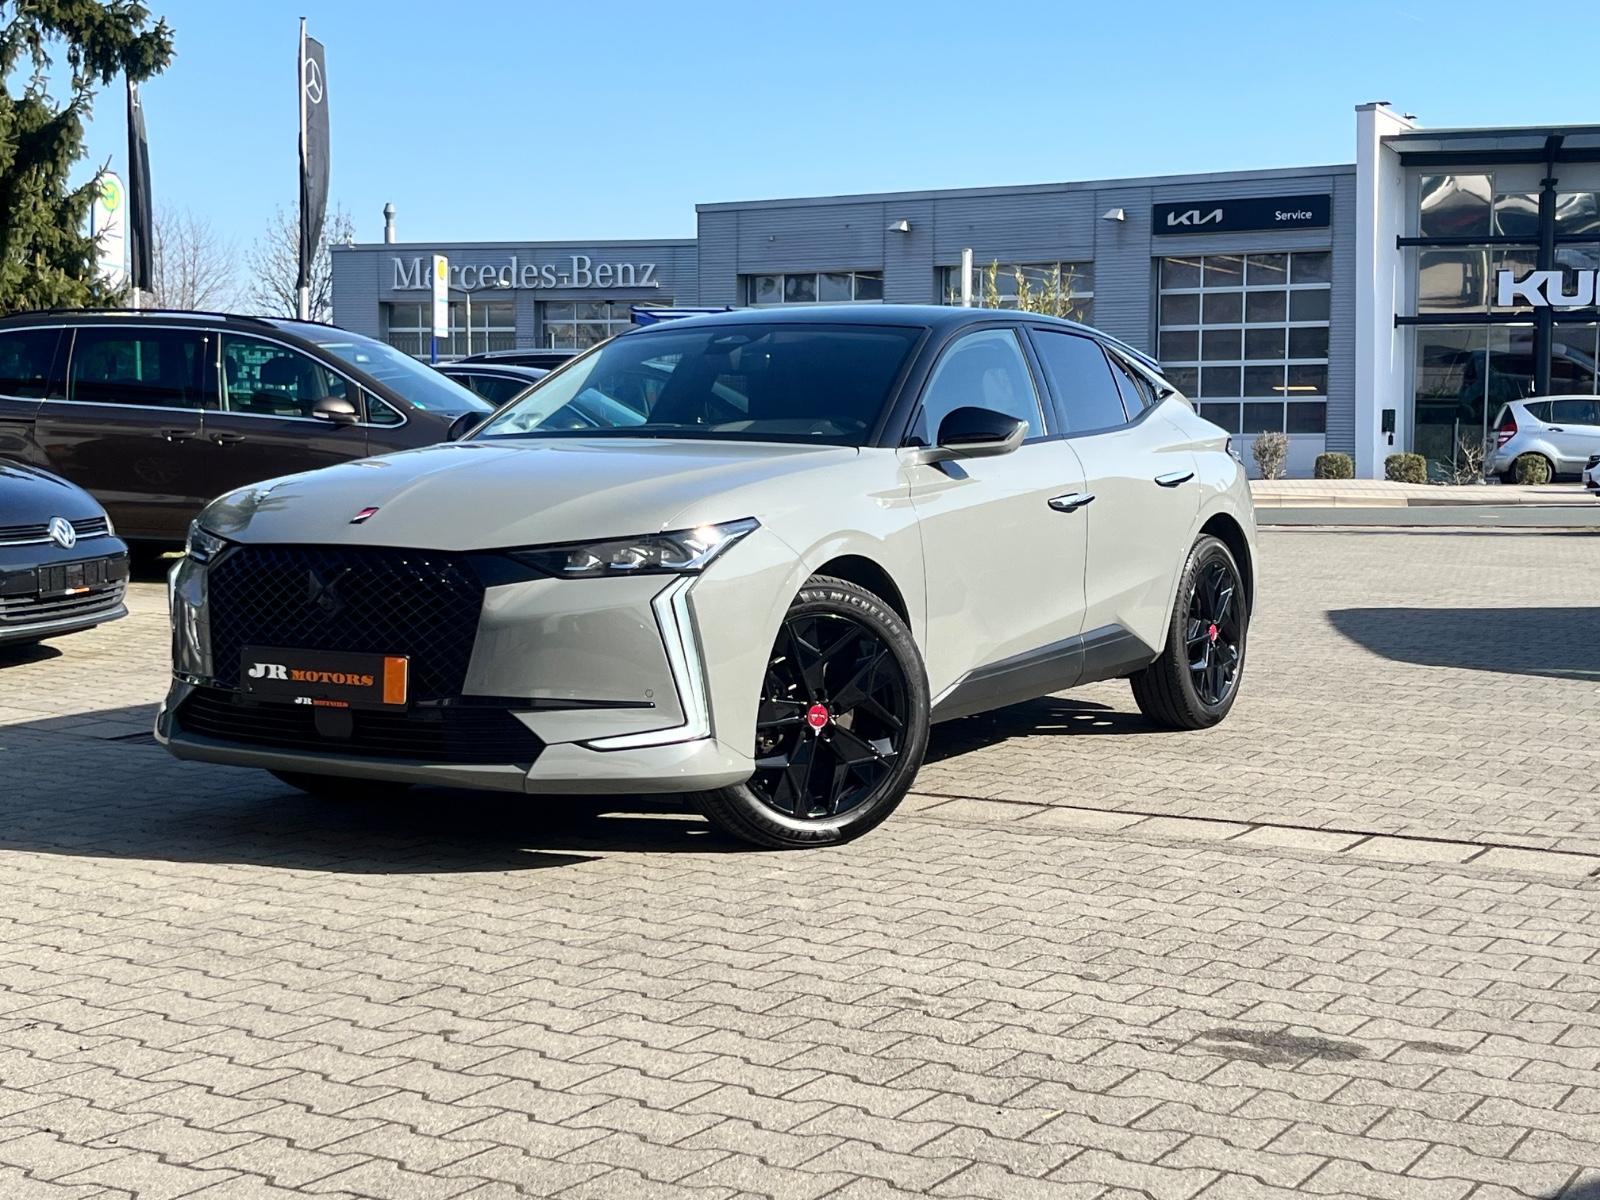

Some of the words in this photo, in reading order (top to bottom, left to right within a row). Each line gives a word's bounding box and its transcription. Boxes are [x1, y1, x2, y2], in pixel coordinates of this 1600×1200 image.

[1274, 210, 1313, 221] Service
[1498, 270, 1600, 306] KU
[830, 590, 900, 635] MICHELIN
[248, 662, 288, 680] JR
[290, 669, 375, 687] MOTORS
[294, 696, 313, 705] JR
